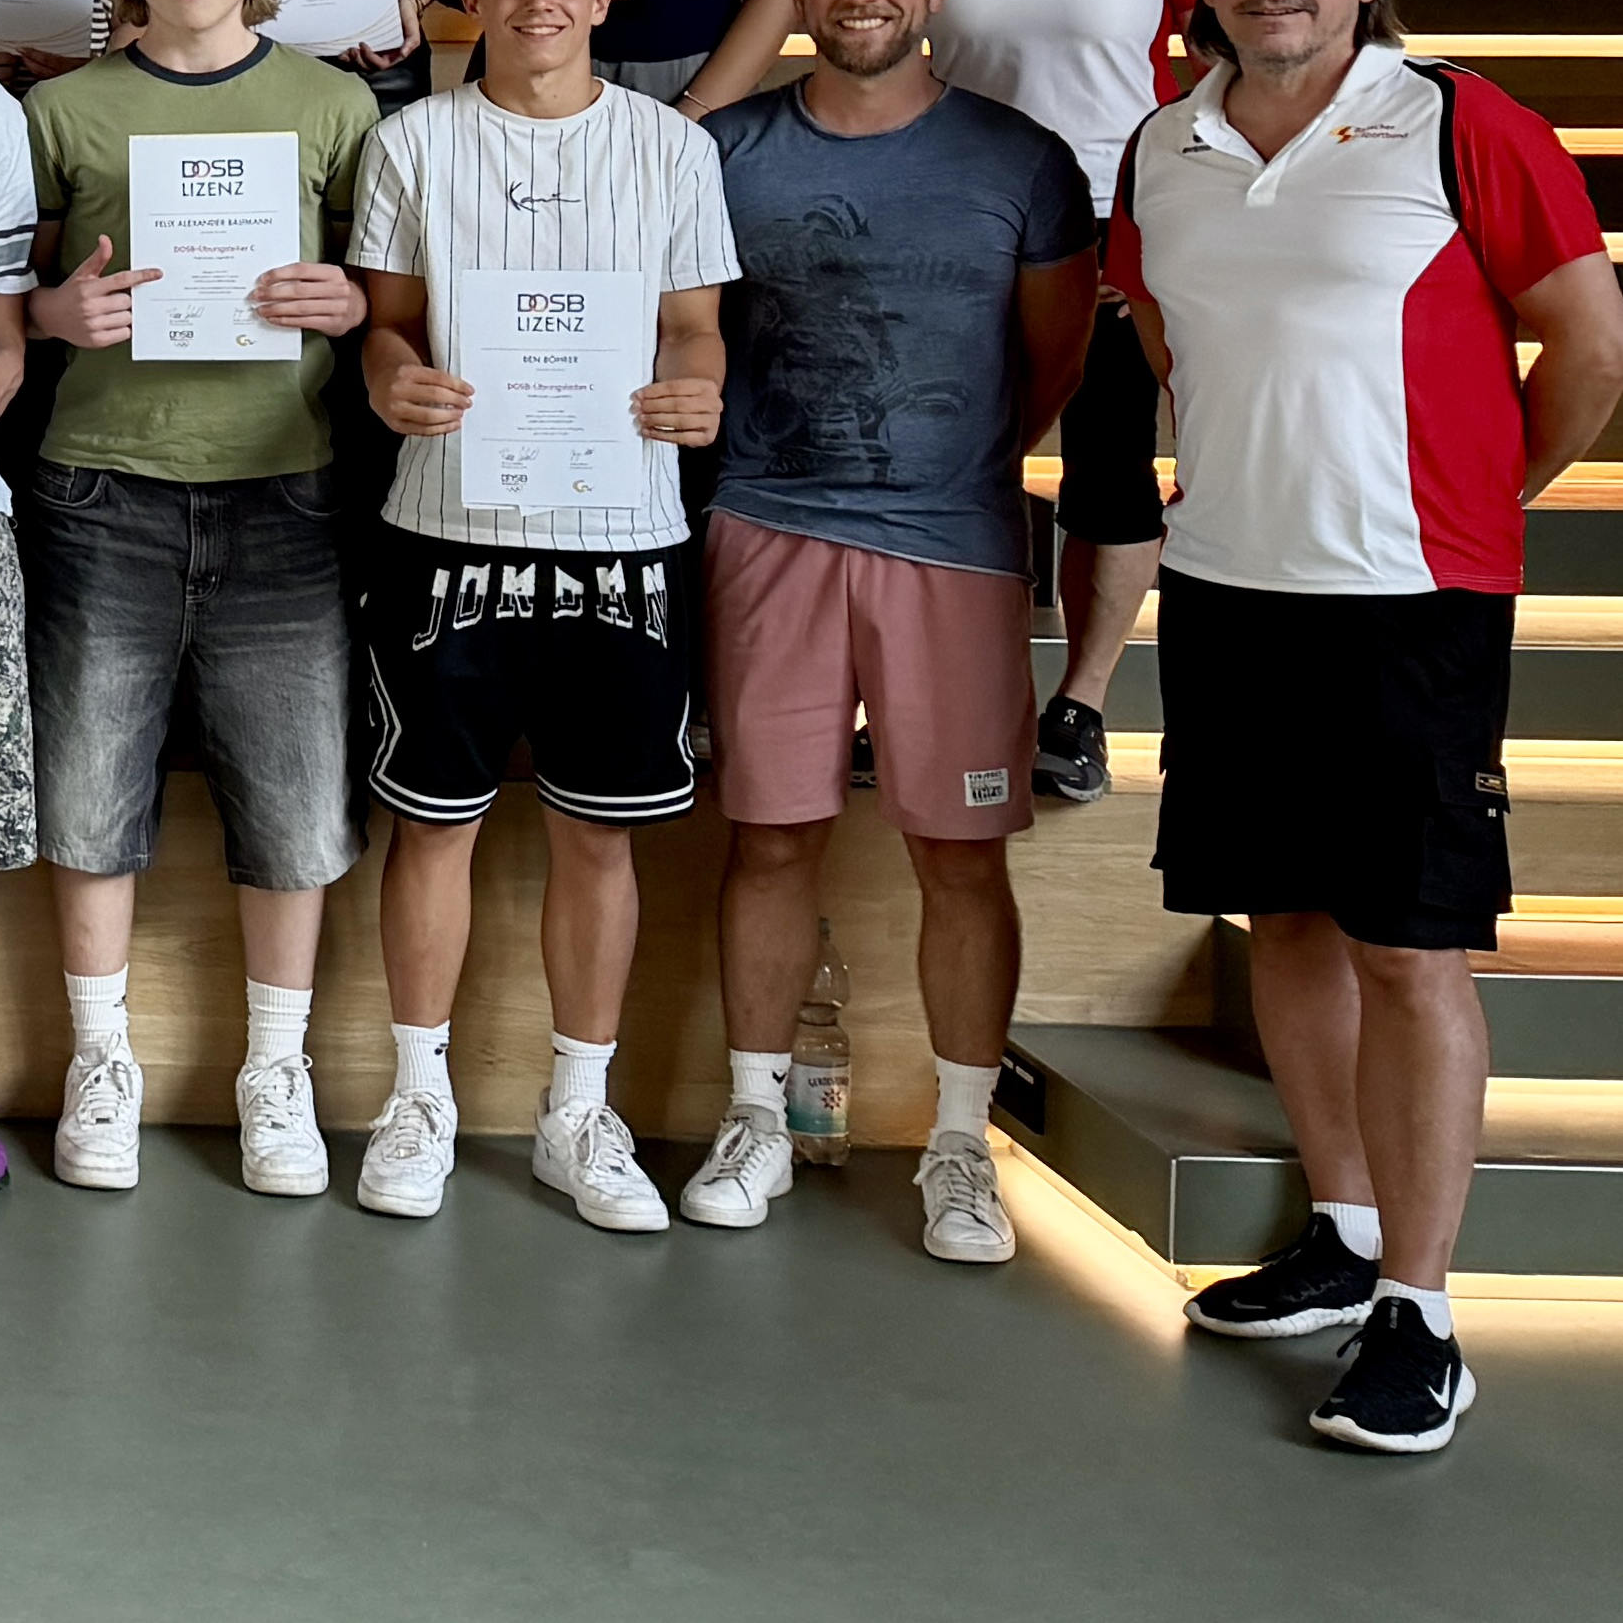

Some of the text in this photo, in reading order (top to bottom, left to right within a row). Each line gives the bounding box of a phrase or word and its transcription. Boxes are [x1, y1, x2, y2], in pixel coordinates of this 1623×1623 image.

[181, 159, 244, 178] DOSB
[181, 180, 244, 197] LIZENZ
[517, 293, 586, 313] DOSB
[517, 316, 585, 332] LIZENZ
[412, 559, 668, 651] JORDAN
